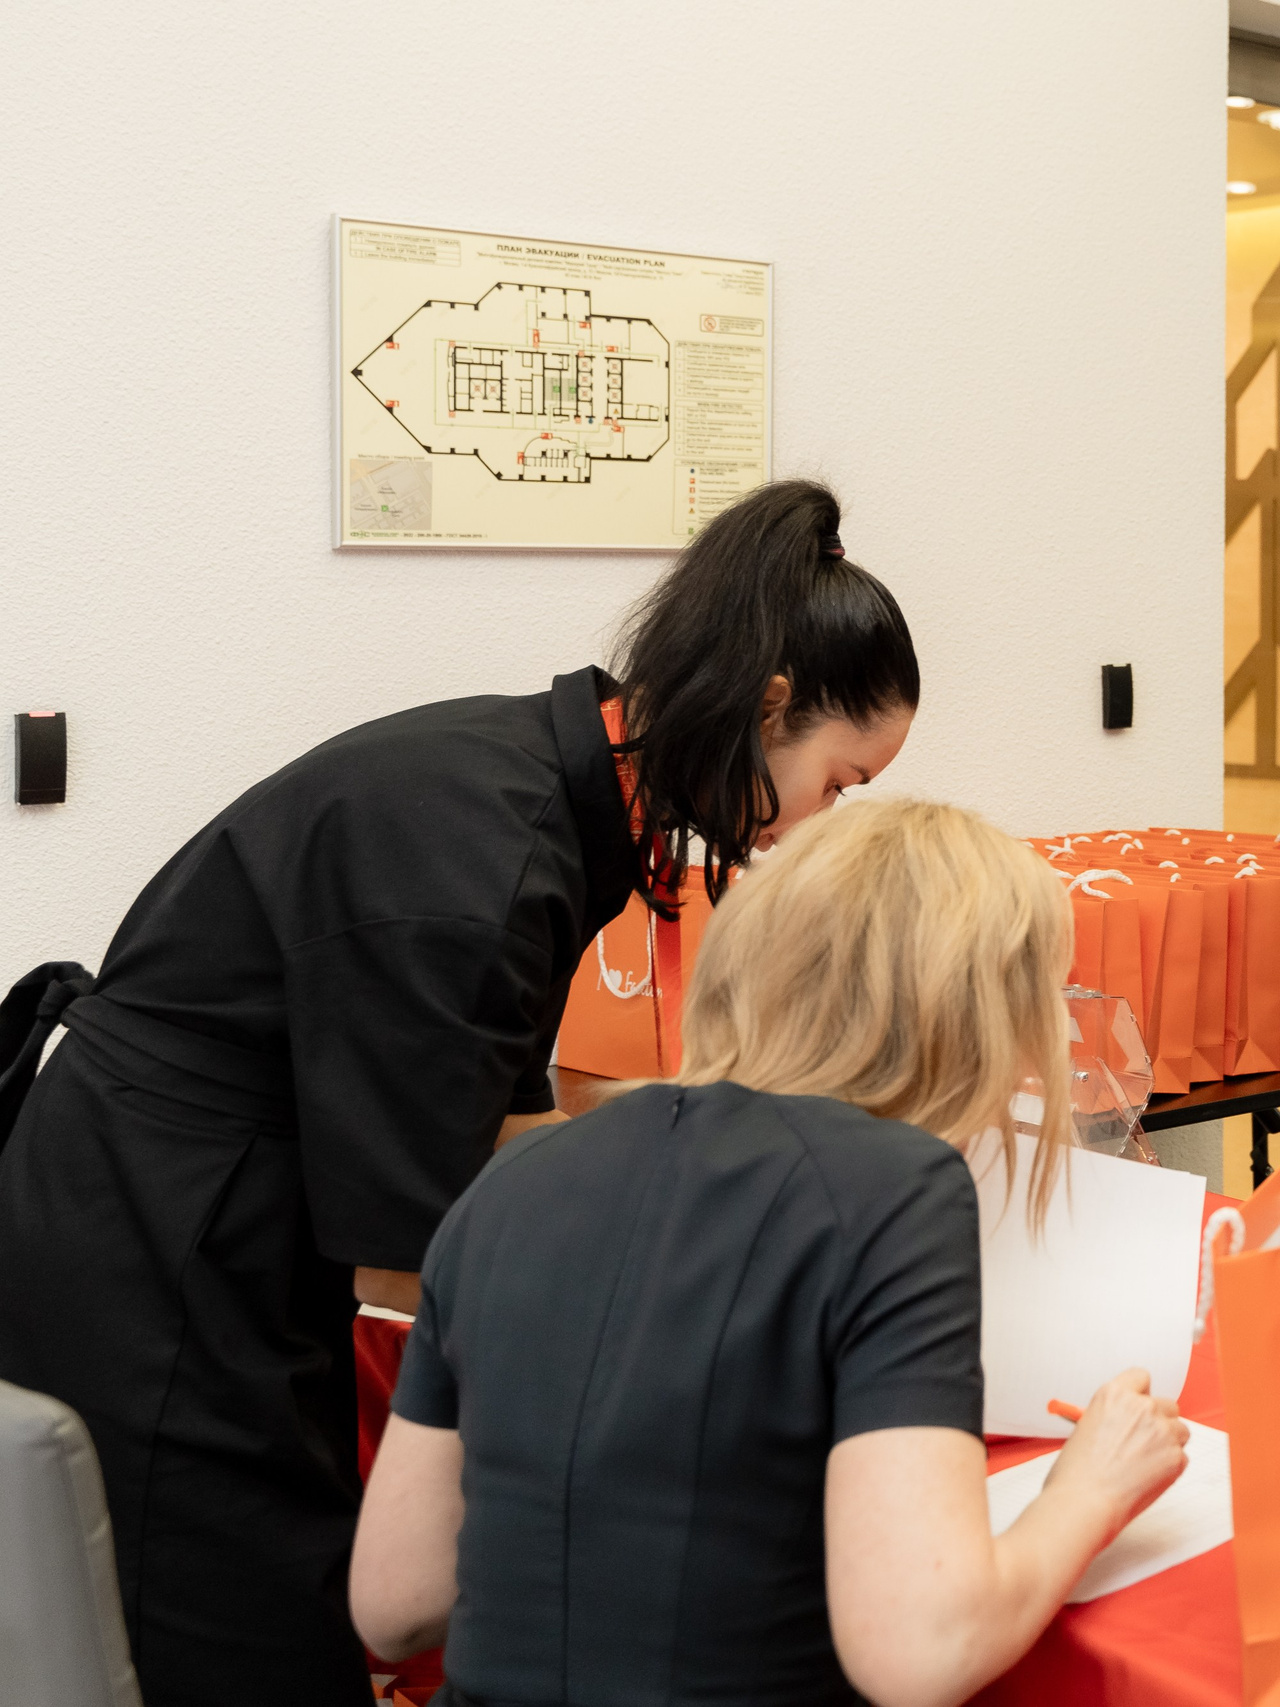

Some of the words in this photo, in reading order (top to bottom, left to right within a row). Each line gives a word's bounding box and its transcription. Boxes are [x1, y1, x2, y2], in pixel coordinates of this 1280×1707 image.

[497, 244, 522, 253] ПЛАН
[526, 247, 580, 259] ЭВАКУАЦИИ
[587, 254, 641, 265] EVACUATION
[643, 260, 666, 268] PLAN
